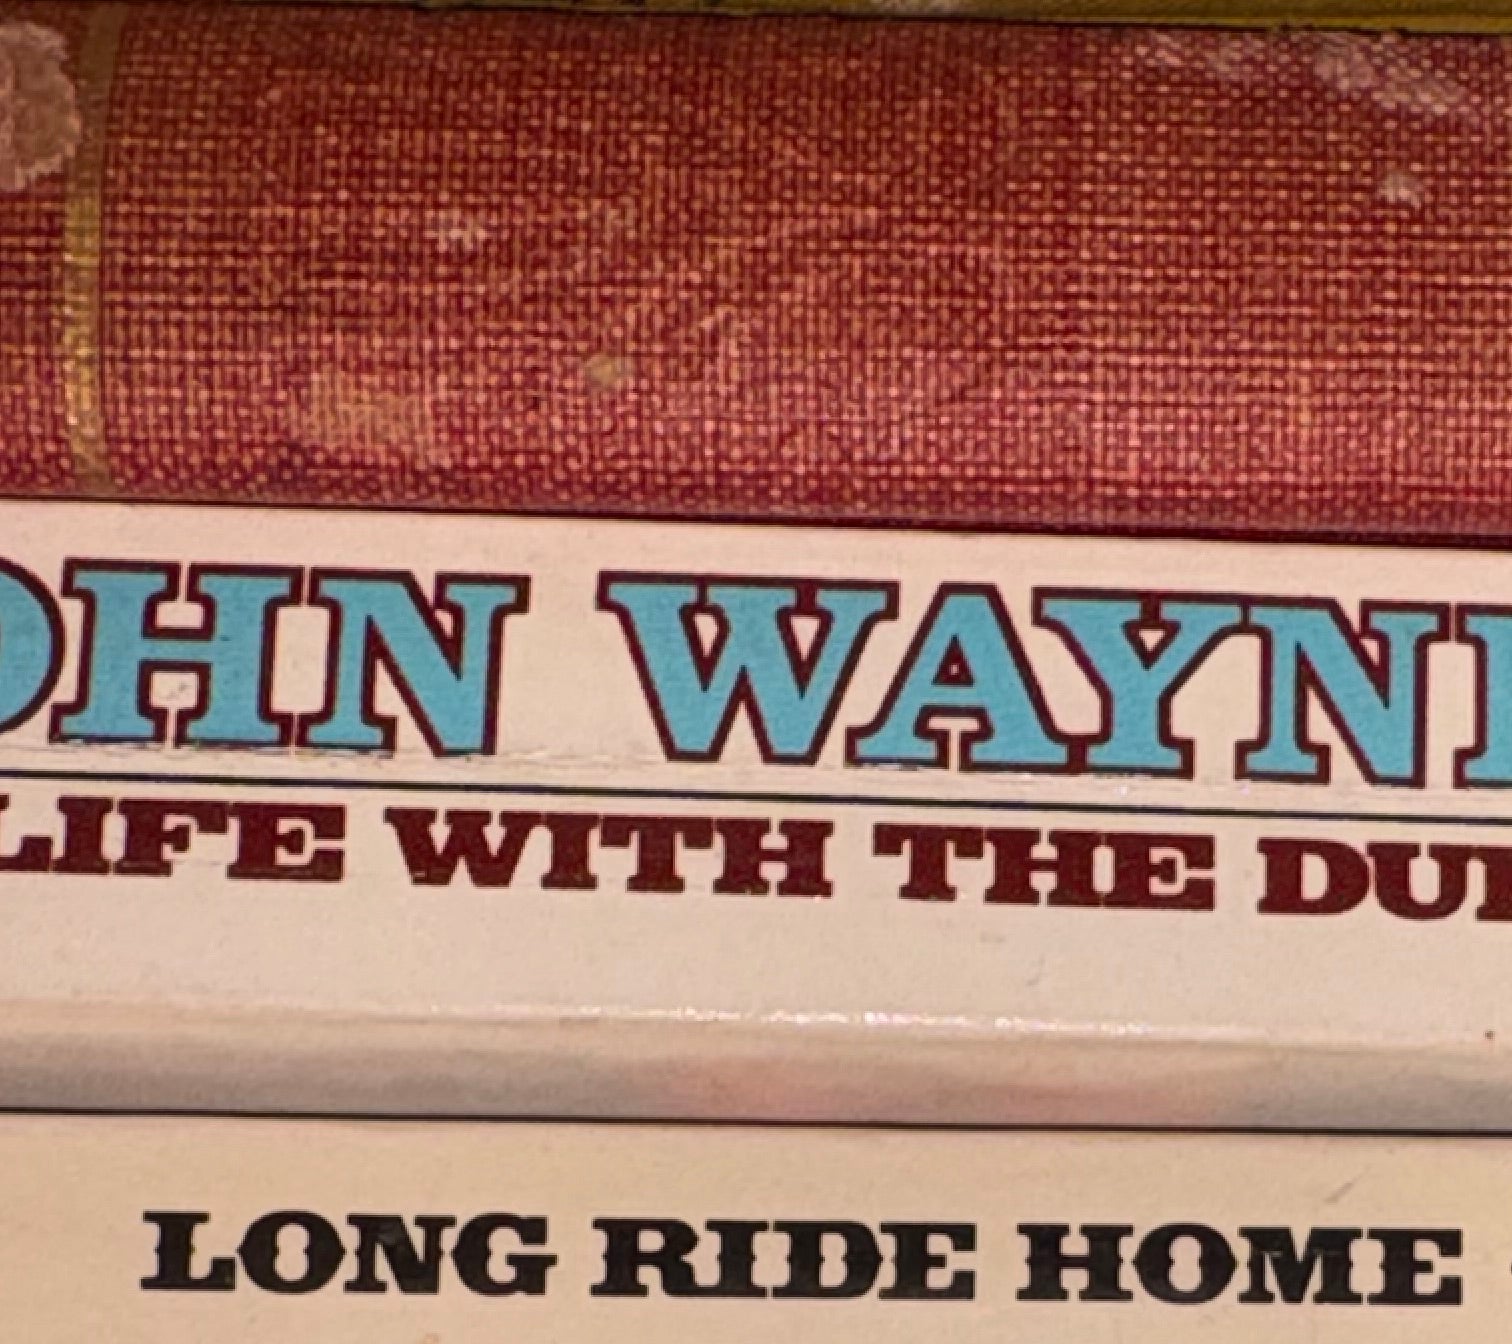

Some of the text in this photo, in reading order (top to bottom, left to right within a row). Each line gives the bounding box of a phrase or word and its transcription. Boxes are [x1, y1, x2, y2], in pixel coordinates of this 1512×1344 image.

[384, 806, 834, 898] WITH
[872, 820, 1215, 911] THE
[140, 1210, 558, 1298] LONG
[590, 1216, 978, 1302] RIDE
[1016, 1222, 1464, 1306] HOME
